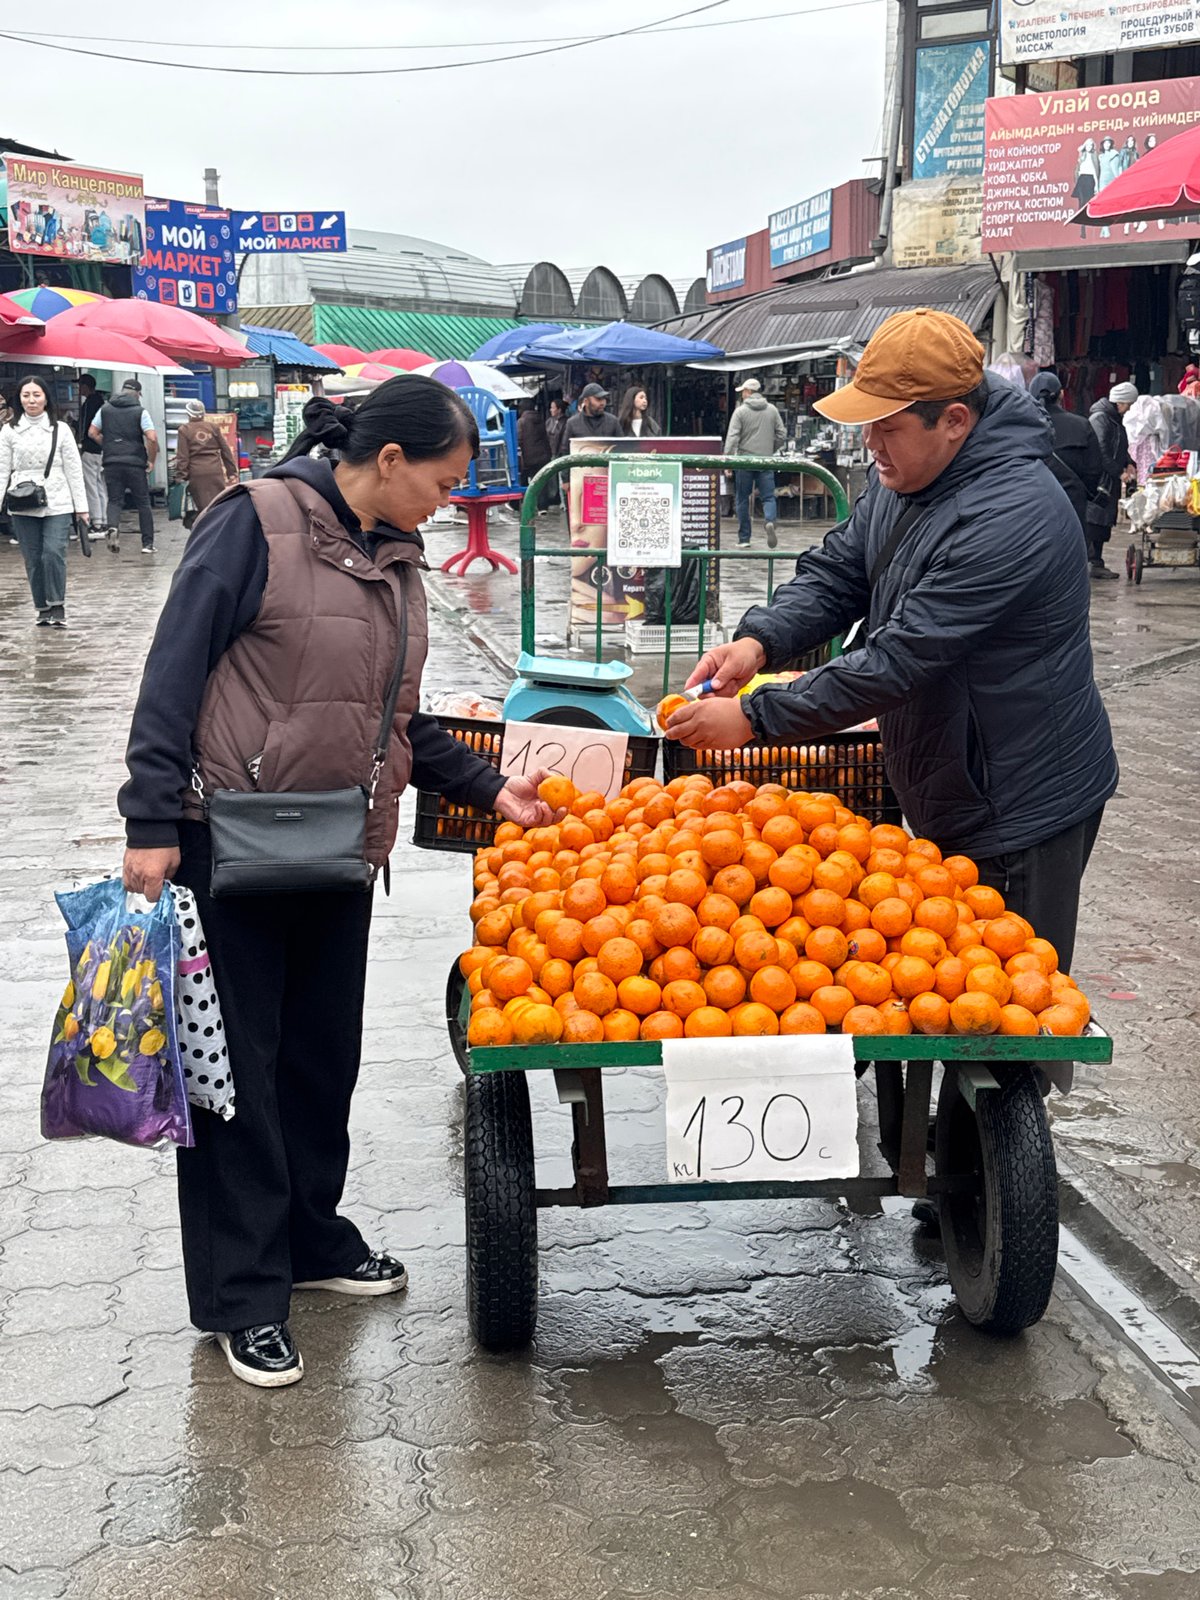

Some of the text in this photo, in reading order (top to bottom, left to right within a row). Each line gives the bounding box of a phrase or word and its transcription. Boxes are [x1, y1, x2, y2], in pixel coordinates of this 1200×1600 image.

[1016, 15, 1057, 29] УДАЛЕНИЕ
[1067, 9, 1105, 21] ЛЕЧЕНИЕ
[1120, 8, 1193, 30] ПРОЦЕДУРНЫЙ
[1016, 26, 1087, 43] КОСМЕТОЛОГИЯ
[1120, 22, 1194, 41] РЕНТГЕН ЗУБОВ
[1016, 42, 1054, 54] МАССАЖ
[915, 46, 987, 165] СТОМАТОЛОГИЯ
[1038, 88, 1161, 116] Улай соода
[989, 122, 1074, 142] АЙЫМДАРДЫН
[13, 163, 144, 199] Мир Канцелярии
[1020, 171, 1048, 182] ЮБКА
[1033, 182, 1070, 195] ПАЛЬТО
[1024, 196, 1064, 209] КОСТЮМ
[1016, 209, 1075, 222] КОСТЮМДАР
[161, 224, 207, 251] МОЙ
[239, 234, 341, 250] МОЙМАРКЕТ
[147, 248, 222, 277] МАРКЕТ
[507, 739, 615, 798] 130
[683, 1093, 812, 1178] 130
